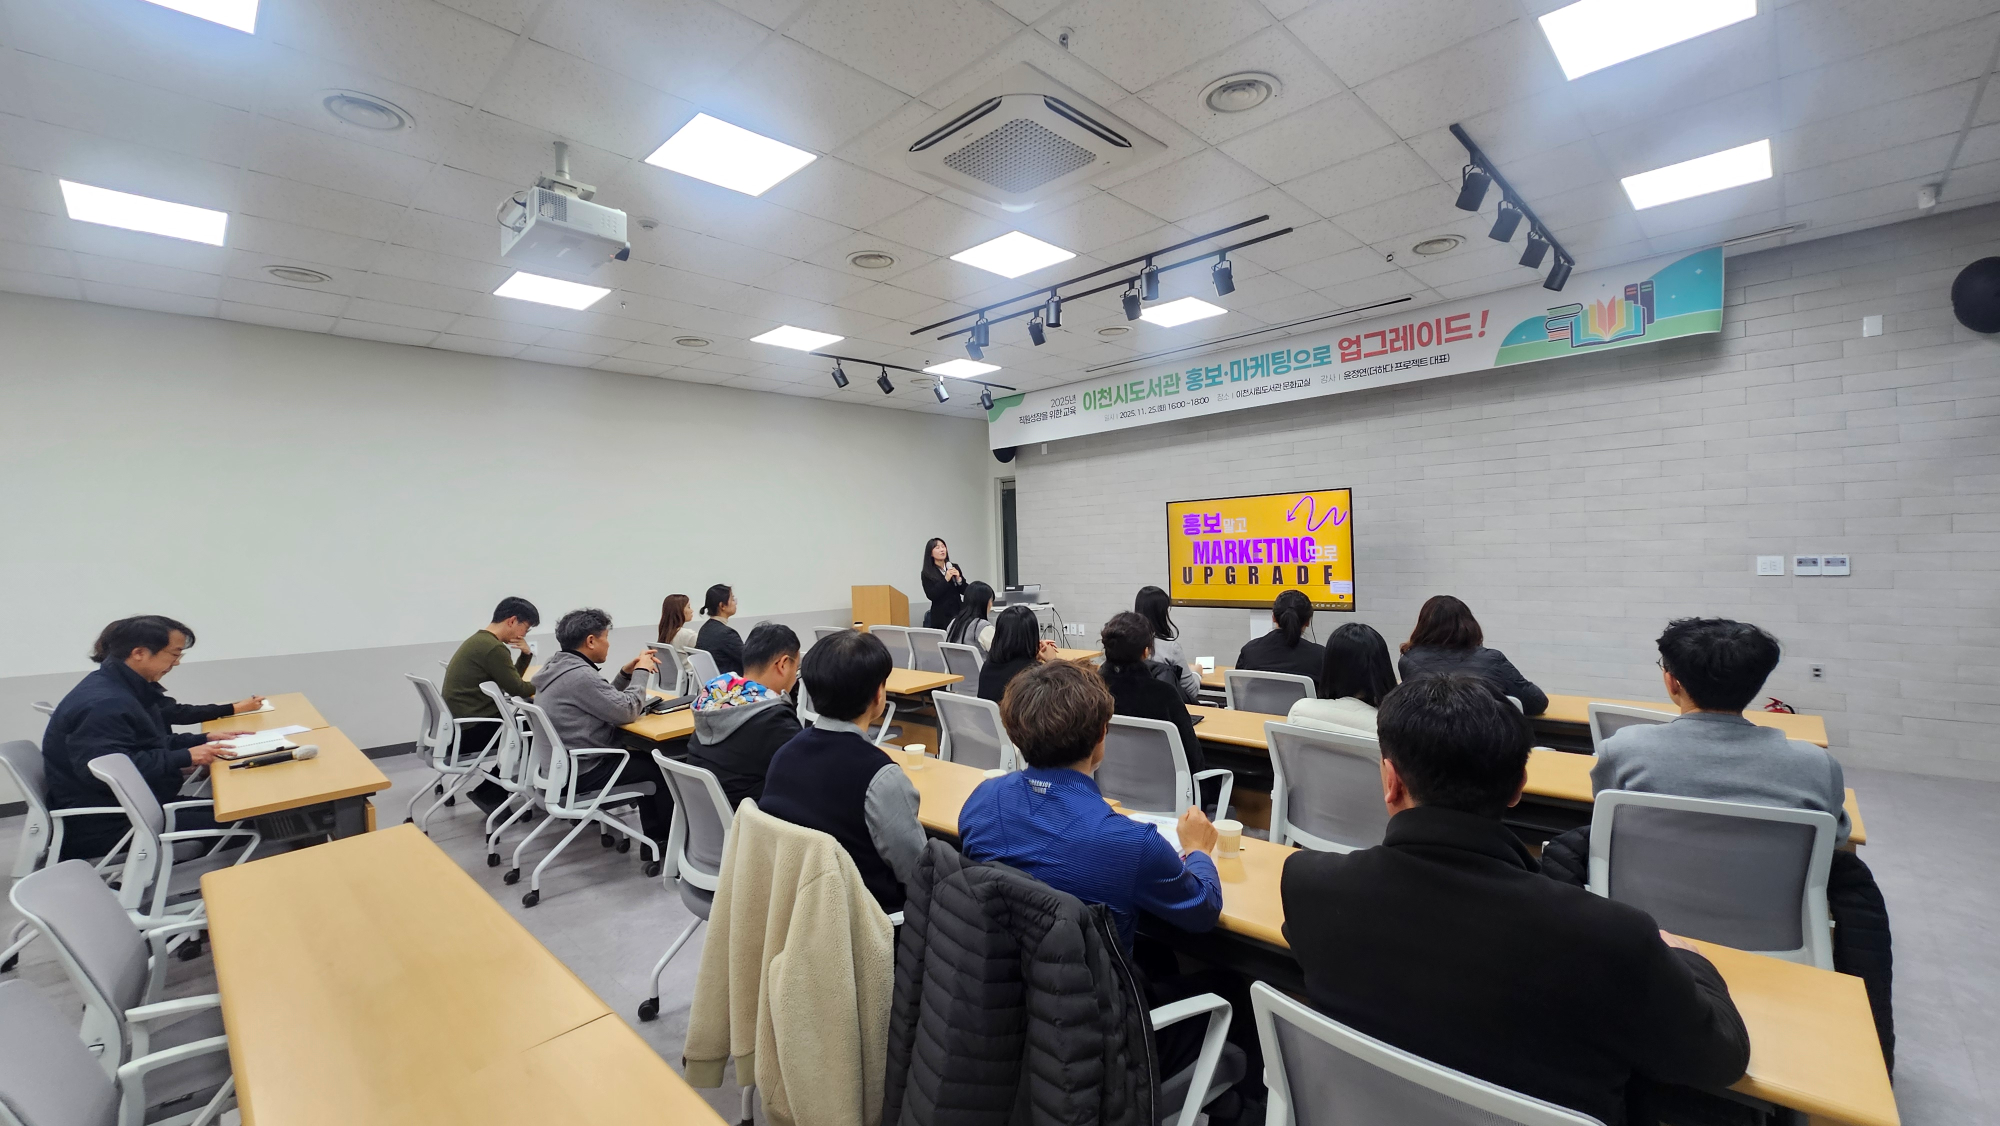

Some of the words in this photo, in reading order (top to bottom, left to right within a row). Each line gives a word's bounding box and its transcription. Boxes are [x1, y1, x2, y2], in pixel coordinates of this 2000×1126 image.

[1320, 373, 1336, 384] 강사
[1394, 357, 1428, 371] 프로젝트
[1429, 353, 1450, 365] 대표)
[1082, 372, 1181, 411] 이천시도서관
[1216, 393, 1230, 402] 장소
[1235, 383, 1282, 398] 이천시립도서관
[1282, 377, 1311, 391] 문화교실
[1050, 394, 1077, 408] 2025년
[1018, 411, 1048, 424] 직원성장을
[1049, 408, 1062, 419] 위한
[1063, 406, 1077, 417] 교육
[1182, 565, 1333, 585] UPGRADE
